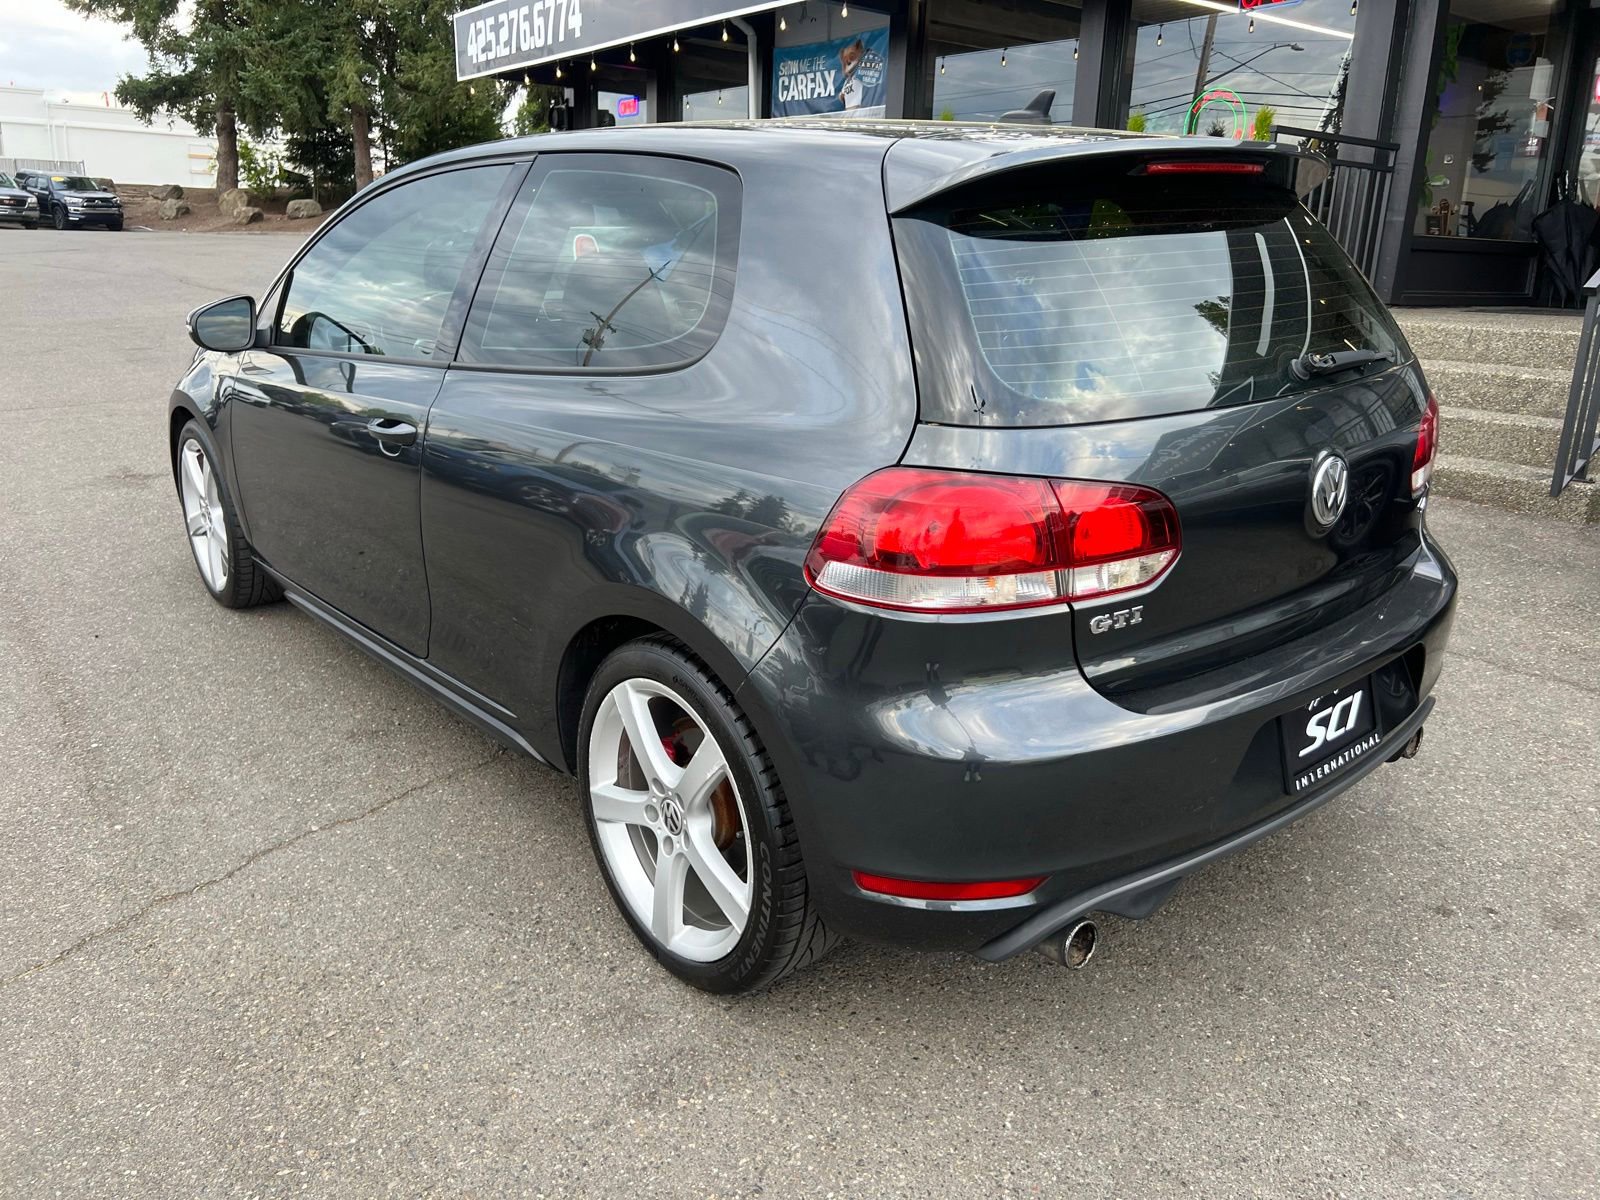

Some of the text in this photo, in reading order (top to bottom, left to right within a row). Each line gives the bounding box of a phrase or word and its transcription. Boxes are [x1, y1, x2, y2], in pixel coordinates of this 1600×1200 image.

[467, 0, 583, 64] 425.276.6774
[779, 69, 836, 102] CARFAX
[812, 55, 827, 71] THE
[1090, 605, 1144, 634] GTI
[1298, 690, 1362, 757] SCI
[1296, 733, 1380, 790] INTERNATIONAL
[728, 841, 772, 981] CONTINENTA
